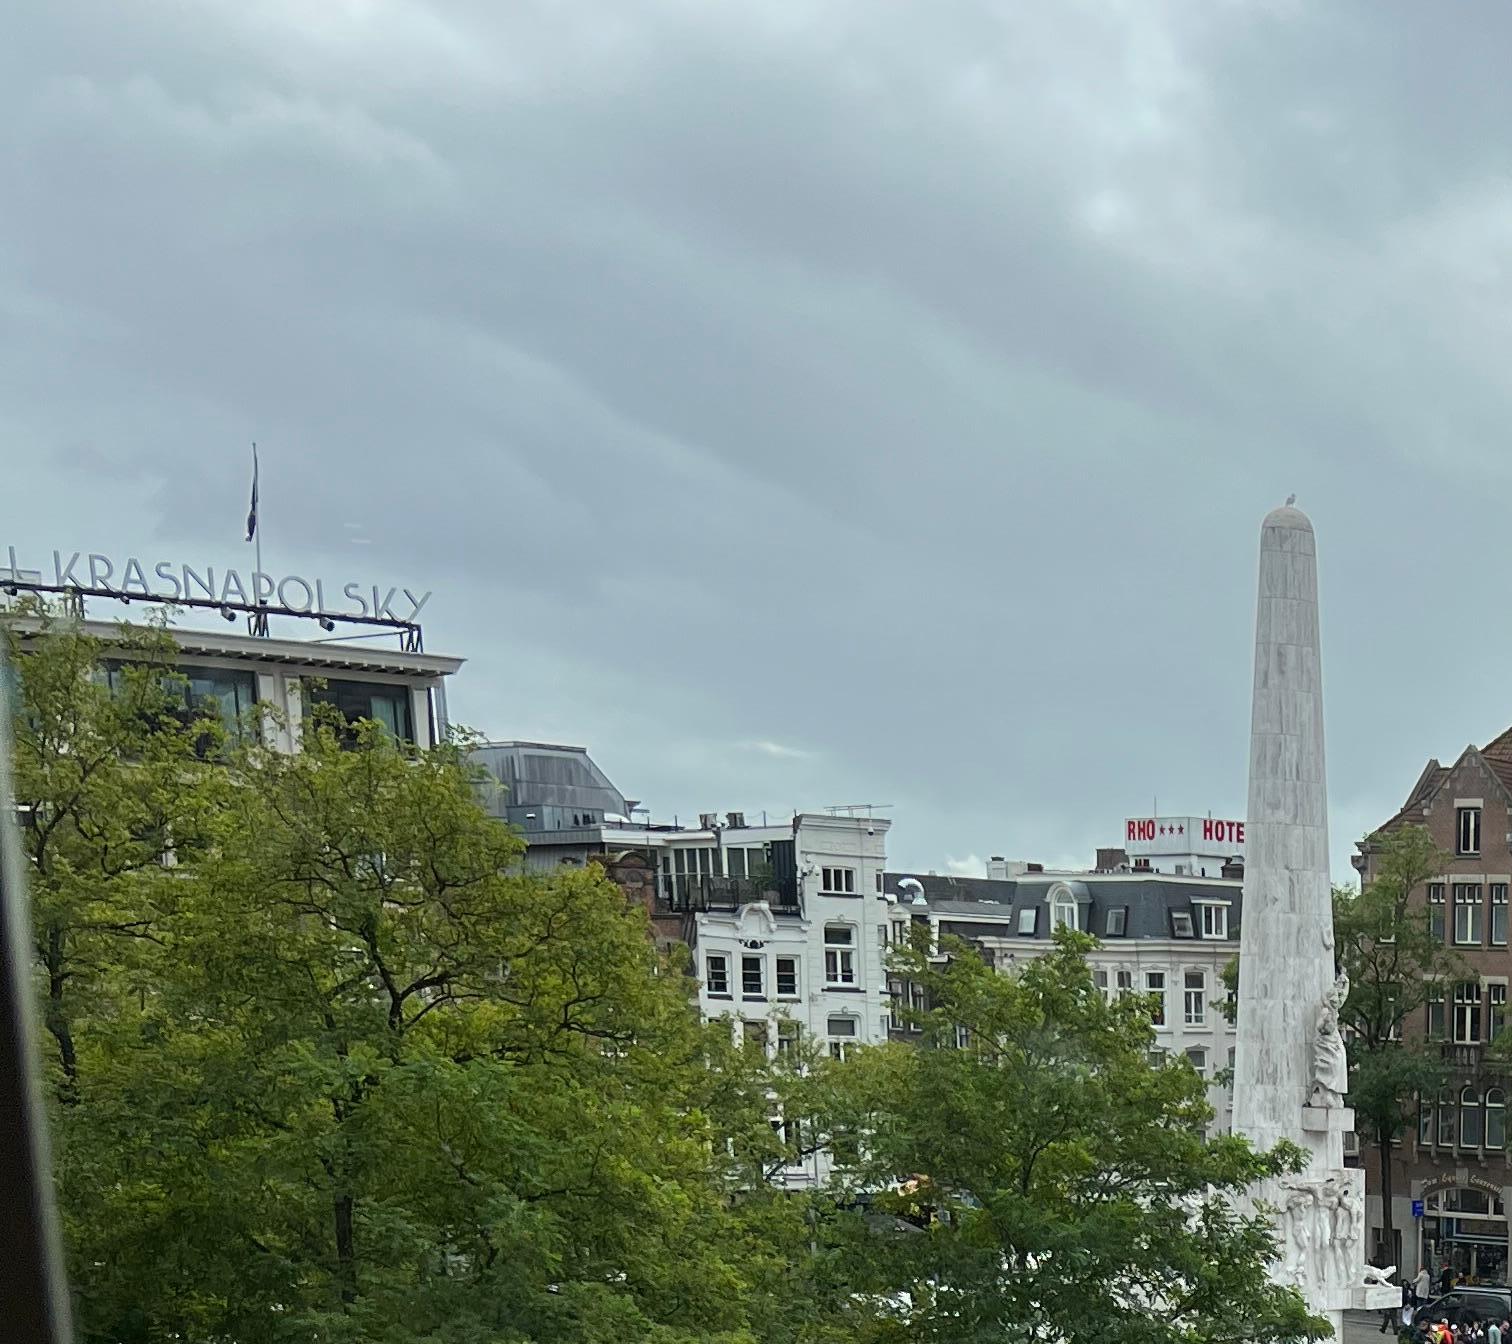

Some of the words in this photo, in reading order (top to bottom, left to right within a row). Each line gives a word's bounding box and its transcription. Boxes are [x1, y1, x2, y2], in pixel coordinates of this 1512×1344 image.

[53, 550, 432, 622] KRASNAPOLSKY
[1127, 819, 1155, 841] RHO
[1204, 820, 1245, 843] HOTE
